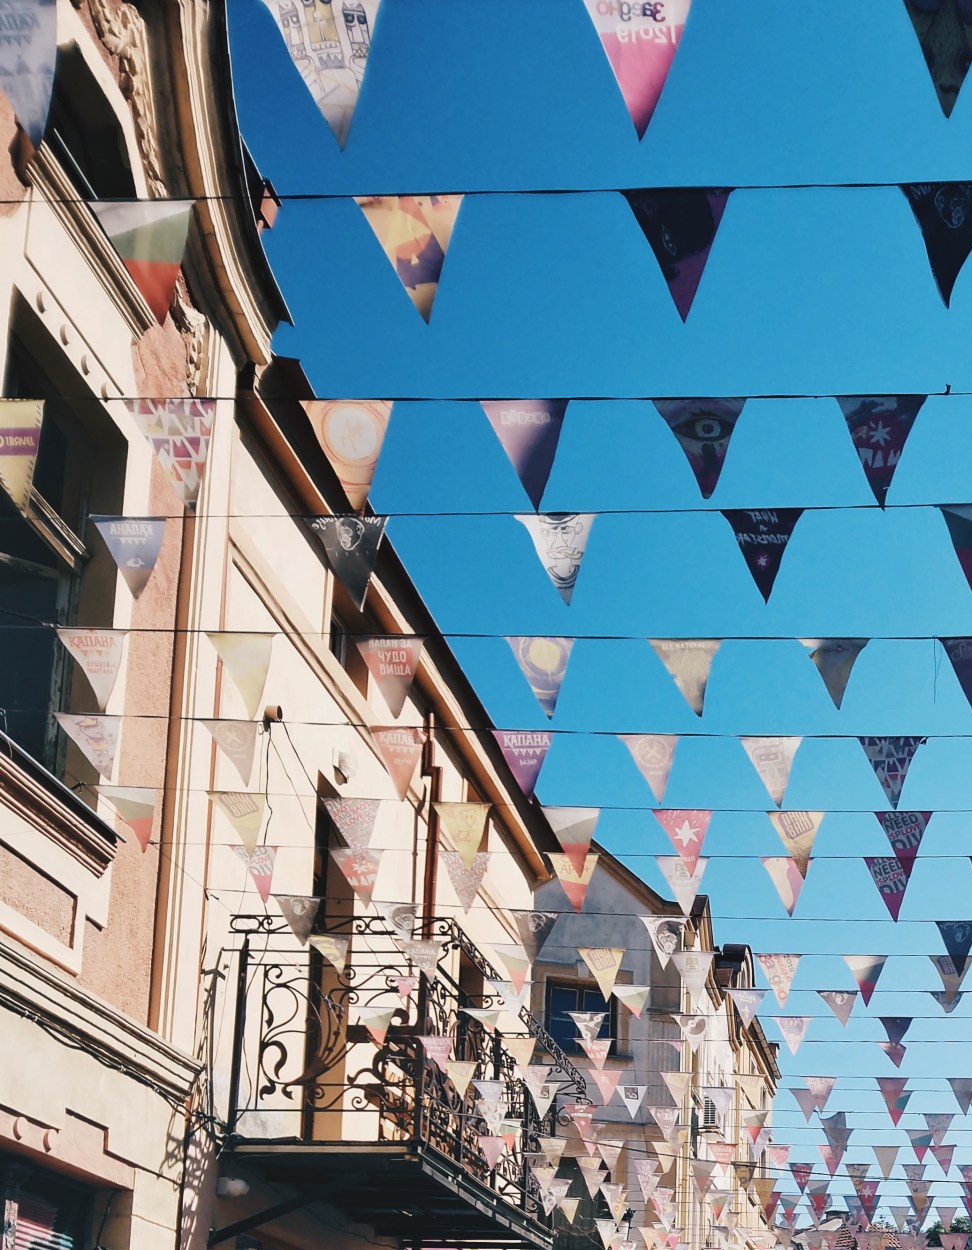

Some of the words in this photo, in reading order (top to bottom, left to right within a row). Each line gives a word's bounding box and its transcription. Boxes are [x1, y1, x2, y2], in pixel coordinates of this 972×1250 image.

[70, 635, 116, 649] КАПАНА
[378, 651, 407, 665] ЧУДО
[380, 664, 412, 677] ВИЩА
[380, 733, 415, 745] КАПАН
[503, 733, 550, 748] КАПАНА
[885, 814, 918, 830] NEED
